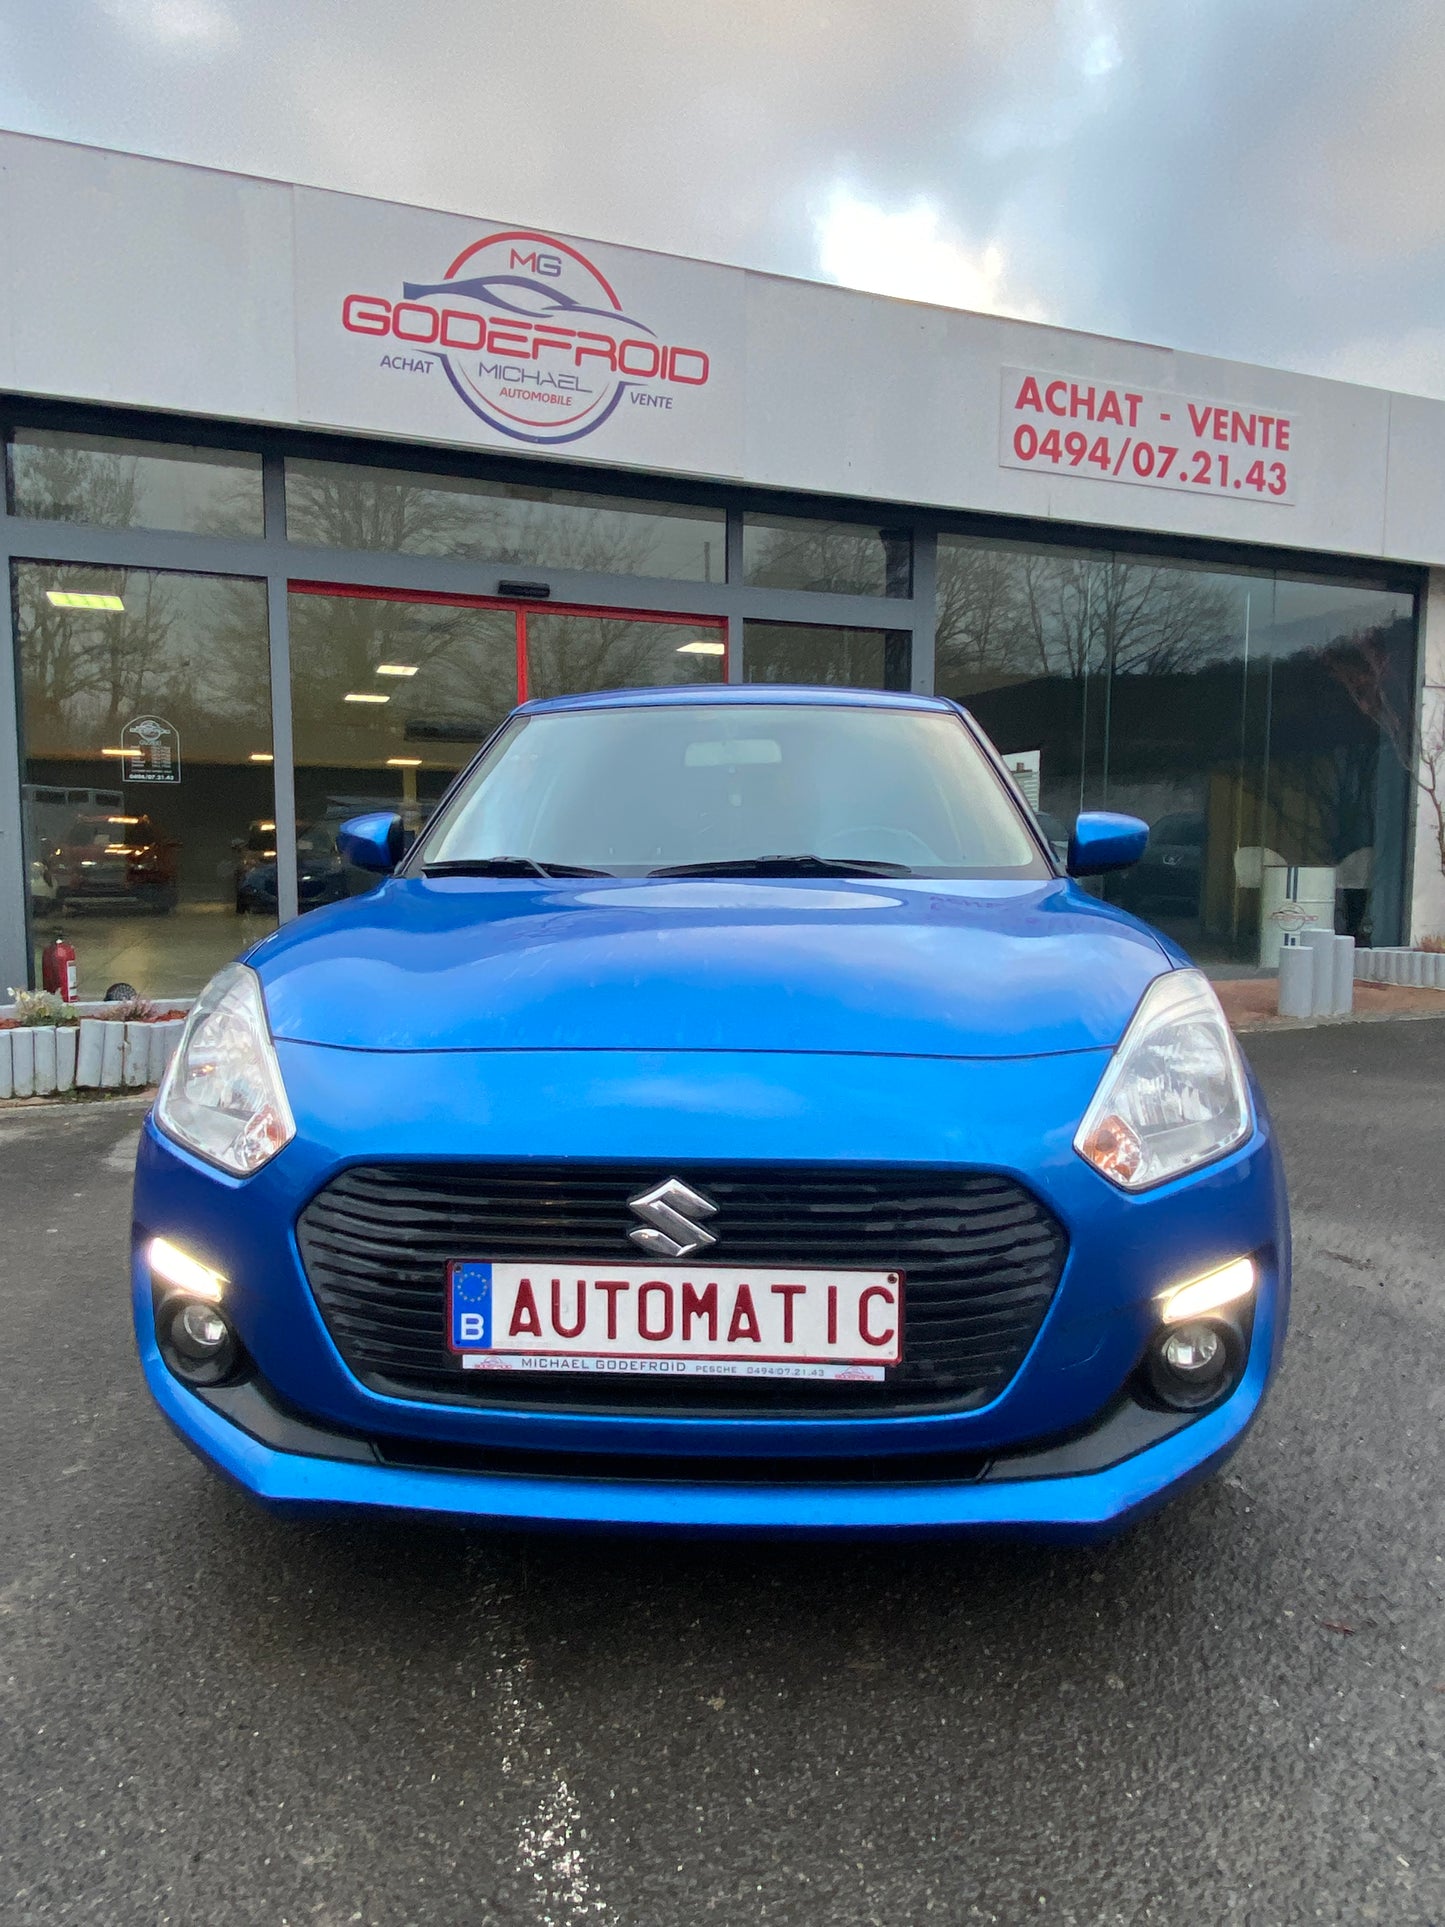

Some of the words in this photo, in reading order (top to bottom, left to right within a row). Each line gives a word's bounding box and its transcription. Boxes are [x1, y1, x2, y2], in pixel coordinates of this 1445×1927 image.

[510, 248, 562, 277] MG
[341, 294, 709, 385] GODEFROID
[380, 355, 434, 374] ACHAT
[478, 361, 593, 393] MICHAEL
[499, 386, 573, 407] AUTOMOBILE
[630, 391, 673, 410] VENTE
[1014, 376, 1143, 427] ACHAT
[1187, 403, 1291, 451] VENTE
[1013, 424, 1287, 496] 0494/07.21.43
[460, 1312, 485, 1341] B
[508, 1278, 895, 1346] AUTOMATIC
[521, 1357, 590, 1369] MICHAEL
[595, 1359, 686, 1373] GODEFROID
